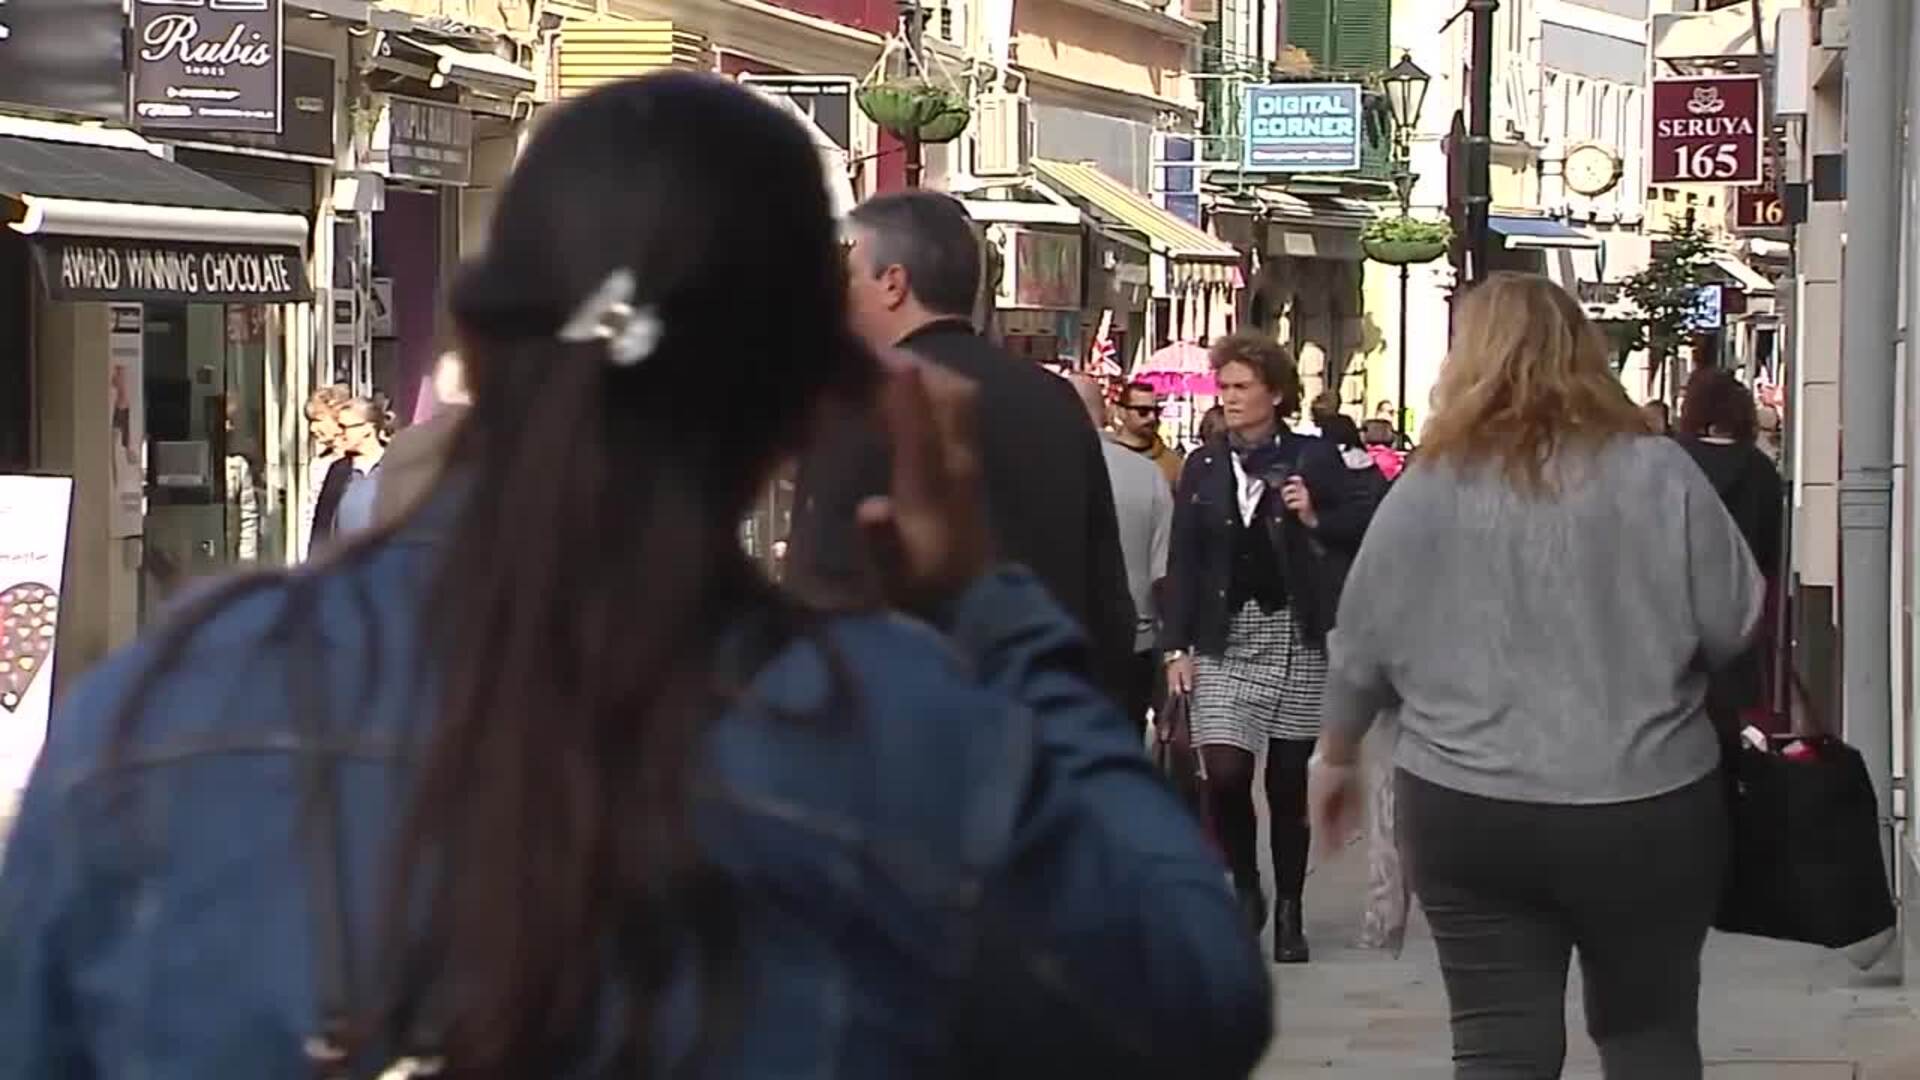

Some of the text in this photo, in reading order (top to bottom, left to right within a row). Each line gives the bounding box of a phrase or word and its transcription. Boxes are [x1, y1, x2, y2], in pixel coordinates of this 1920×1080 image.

[140, 13, 271, 66] Rubis
[184, 66, 226, 76] SHOES
[1257, 95, 1350, 116] DIGITAL
[1252, 116, 1354, 137] CORNER
[1657, 117, 1754, 138] SERUYA
[1673, 144, 1739, 178] 165
[62, 245, 291, 293] AWARD WINNING CHOCOLATE
